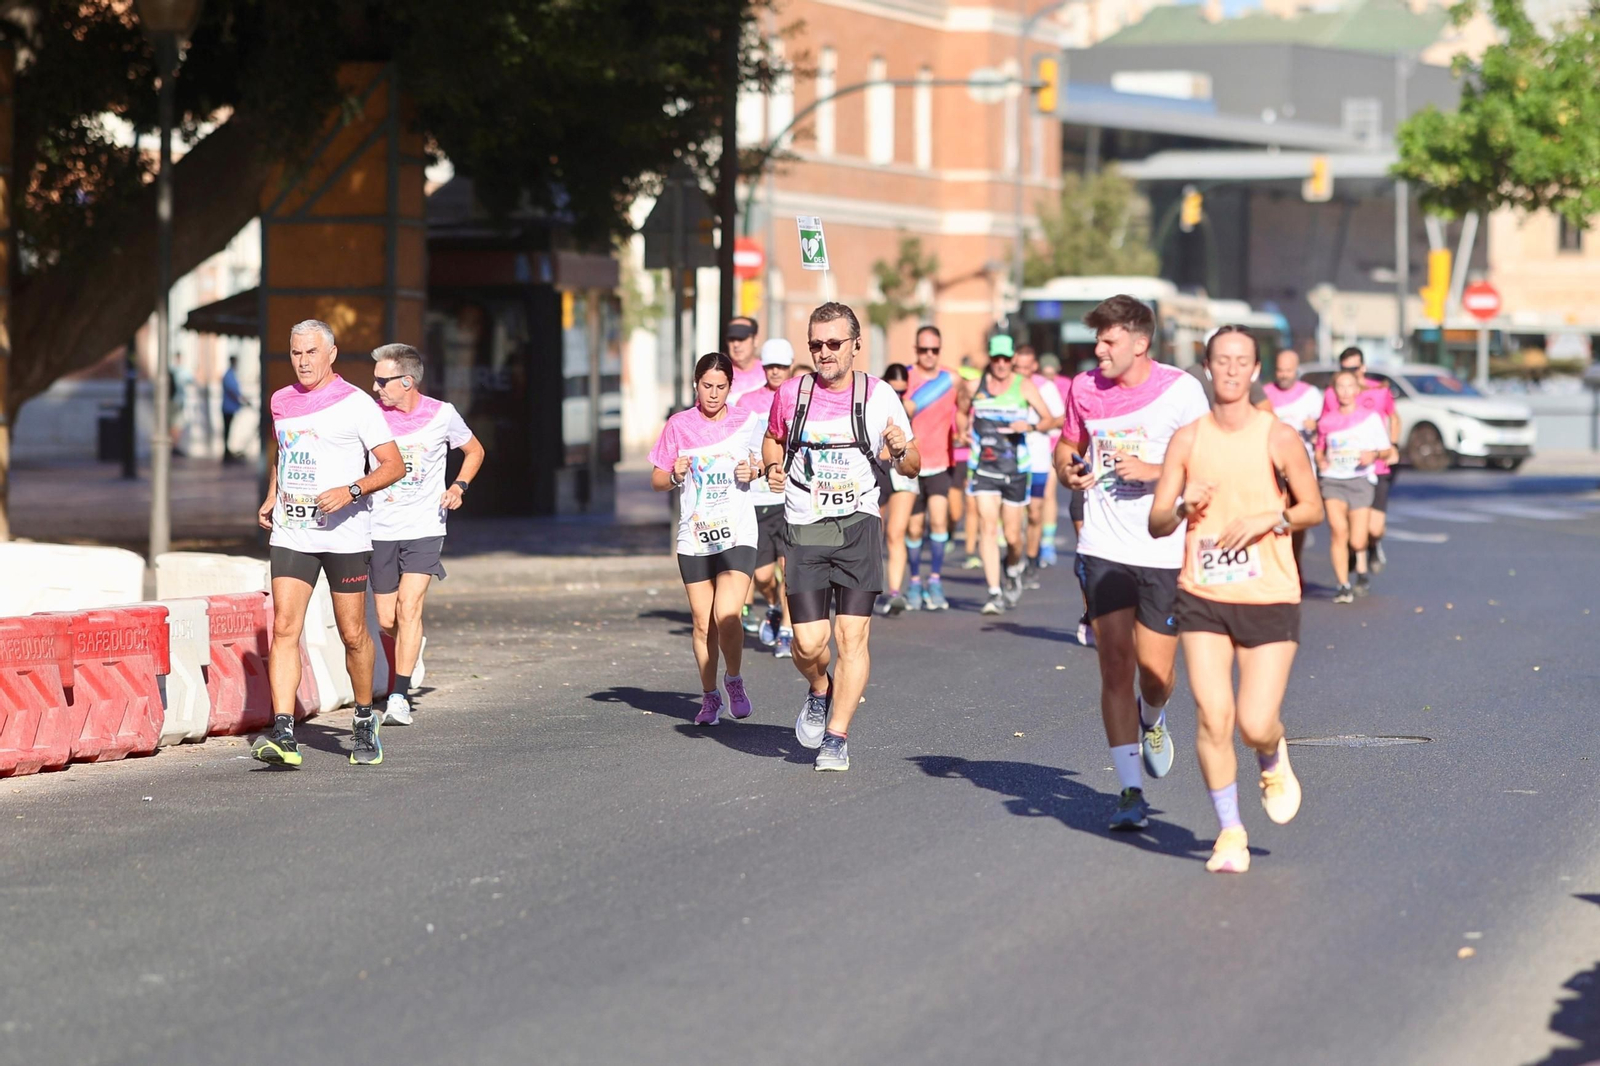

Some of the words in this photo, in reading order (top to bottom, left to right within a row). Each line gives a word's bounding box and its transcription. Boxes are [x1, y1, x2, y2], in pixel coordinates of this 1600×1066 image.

[287, 471, 316, 481] 2025
[817, 471, 847, 480] 2025
[819, 490, 855, 506] 765
[286, 504, 318, 518] 297
[699, 526, 731, 543] 306
[0, 636, 55, 660] AFEDLOCK
